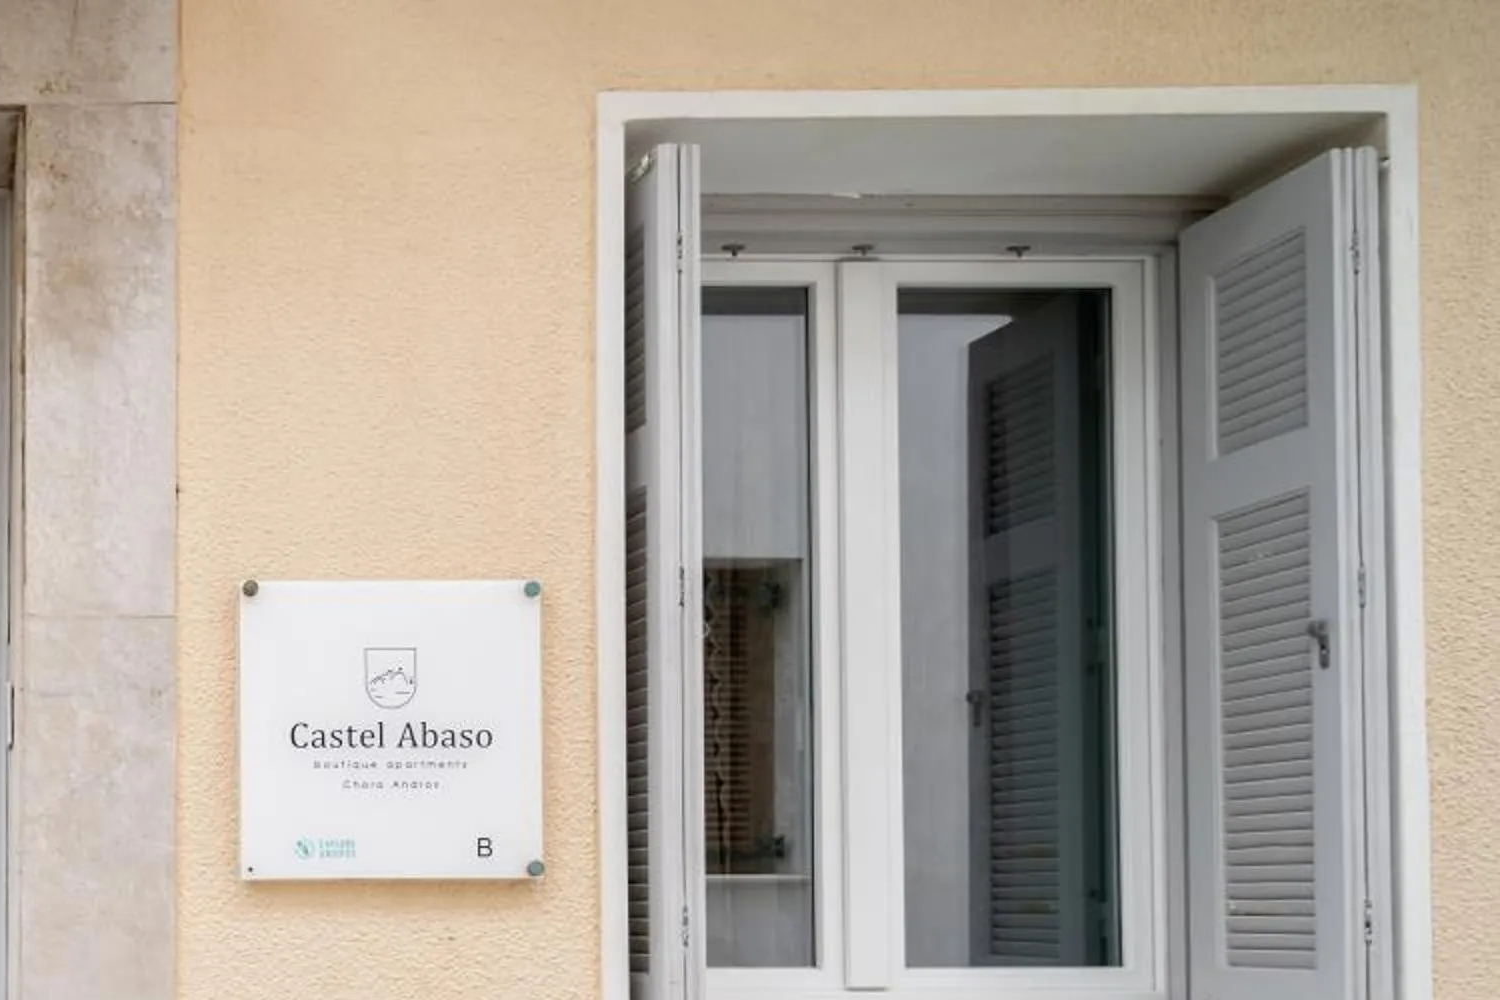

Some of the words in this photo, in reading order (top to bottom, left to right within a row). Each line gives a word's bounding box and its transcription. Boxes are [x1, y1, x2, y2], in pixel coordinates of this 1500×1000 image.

[290, 721, 384, 749] Castel
[397, 721, 493, 749] Abaso
[386, 760, 468, 770] apartments
[476, 837, 493, 857] B
